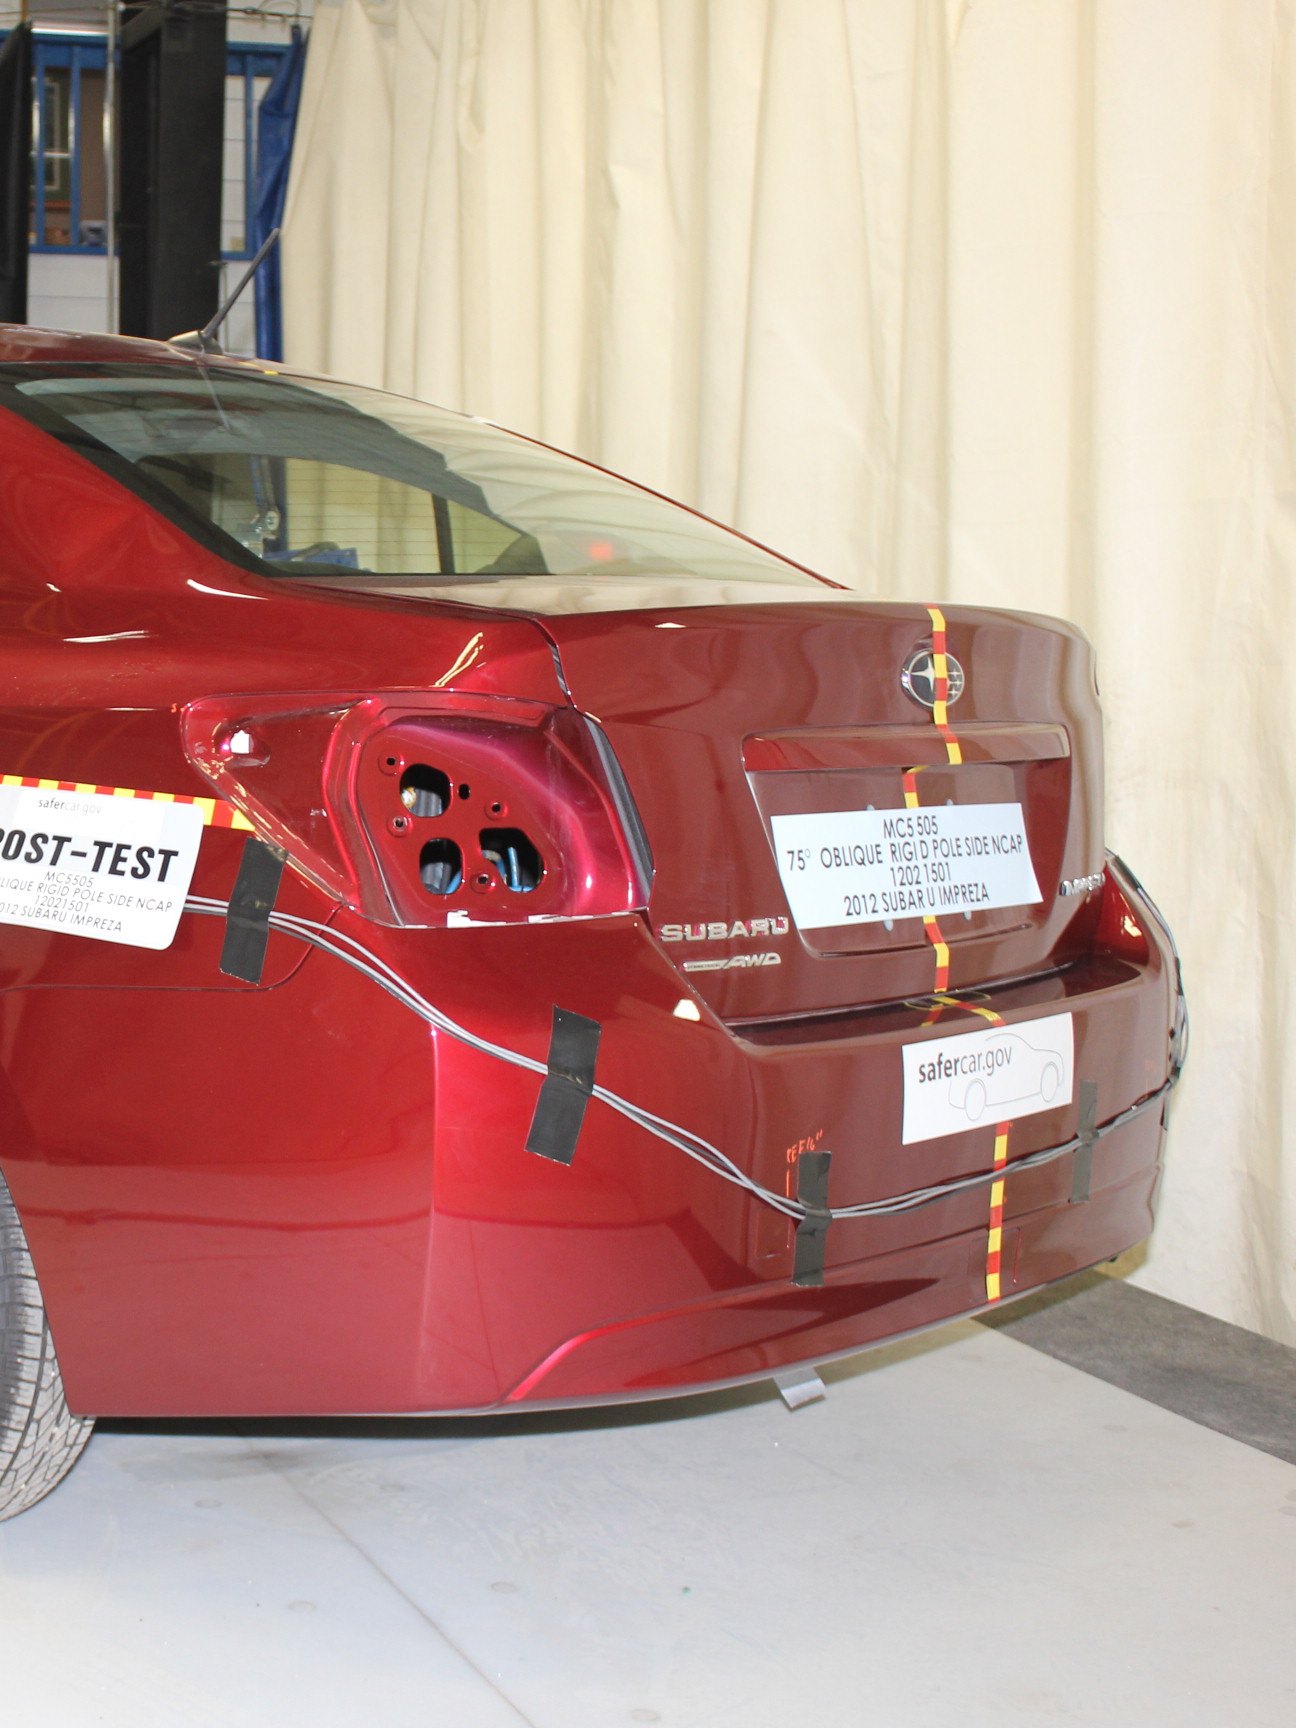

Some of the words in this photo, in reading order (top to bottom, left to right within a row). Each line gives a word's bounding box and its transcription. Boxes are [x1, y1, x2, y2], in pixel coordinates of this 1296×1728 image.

[38, 797, 102, 815] safercar.gov
[820, 844, 883, 868] OBLIQUE
[890, 840, 929, 863] RIGID
[932, 838, 962, 858] POLE
[965, 836, 990, 856] SIDE
[991, 834, 1022, 854] NCAP
[44, 871, 94, 888] MC5505
[35, 895, 89, 912] 12021501
[36, 882, 69, 897] RIGID
[73, 888, 104, 902] POLE
[106, 894, 133, 907] SIDE
[136, 898, 173, 912] NCAP
[844, 893, 879, 916] 2012
[938, 882, 990, 906] IMPREZA
[20, 905, 67, 923] SUBARU
[70, 913, 122, 932] IMPREZA
[661, 917, 789, 942] SUBARU
[722, 952, 782, 969] AWD
[918, 1044, 1013, 1085] safercar.gov
